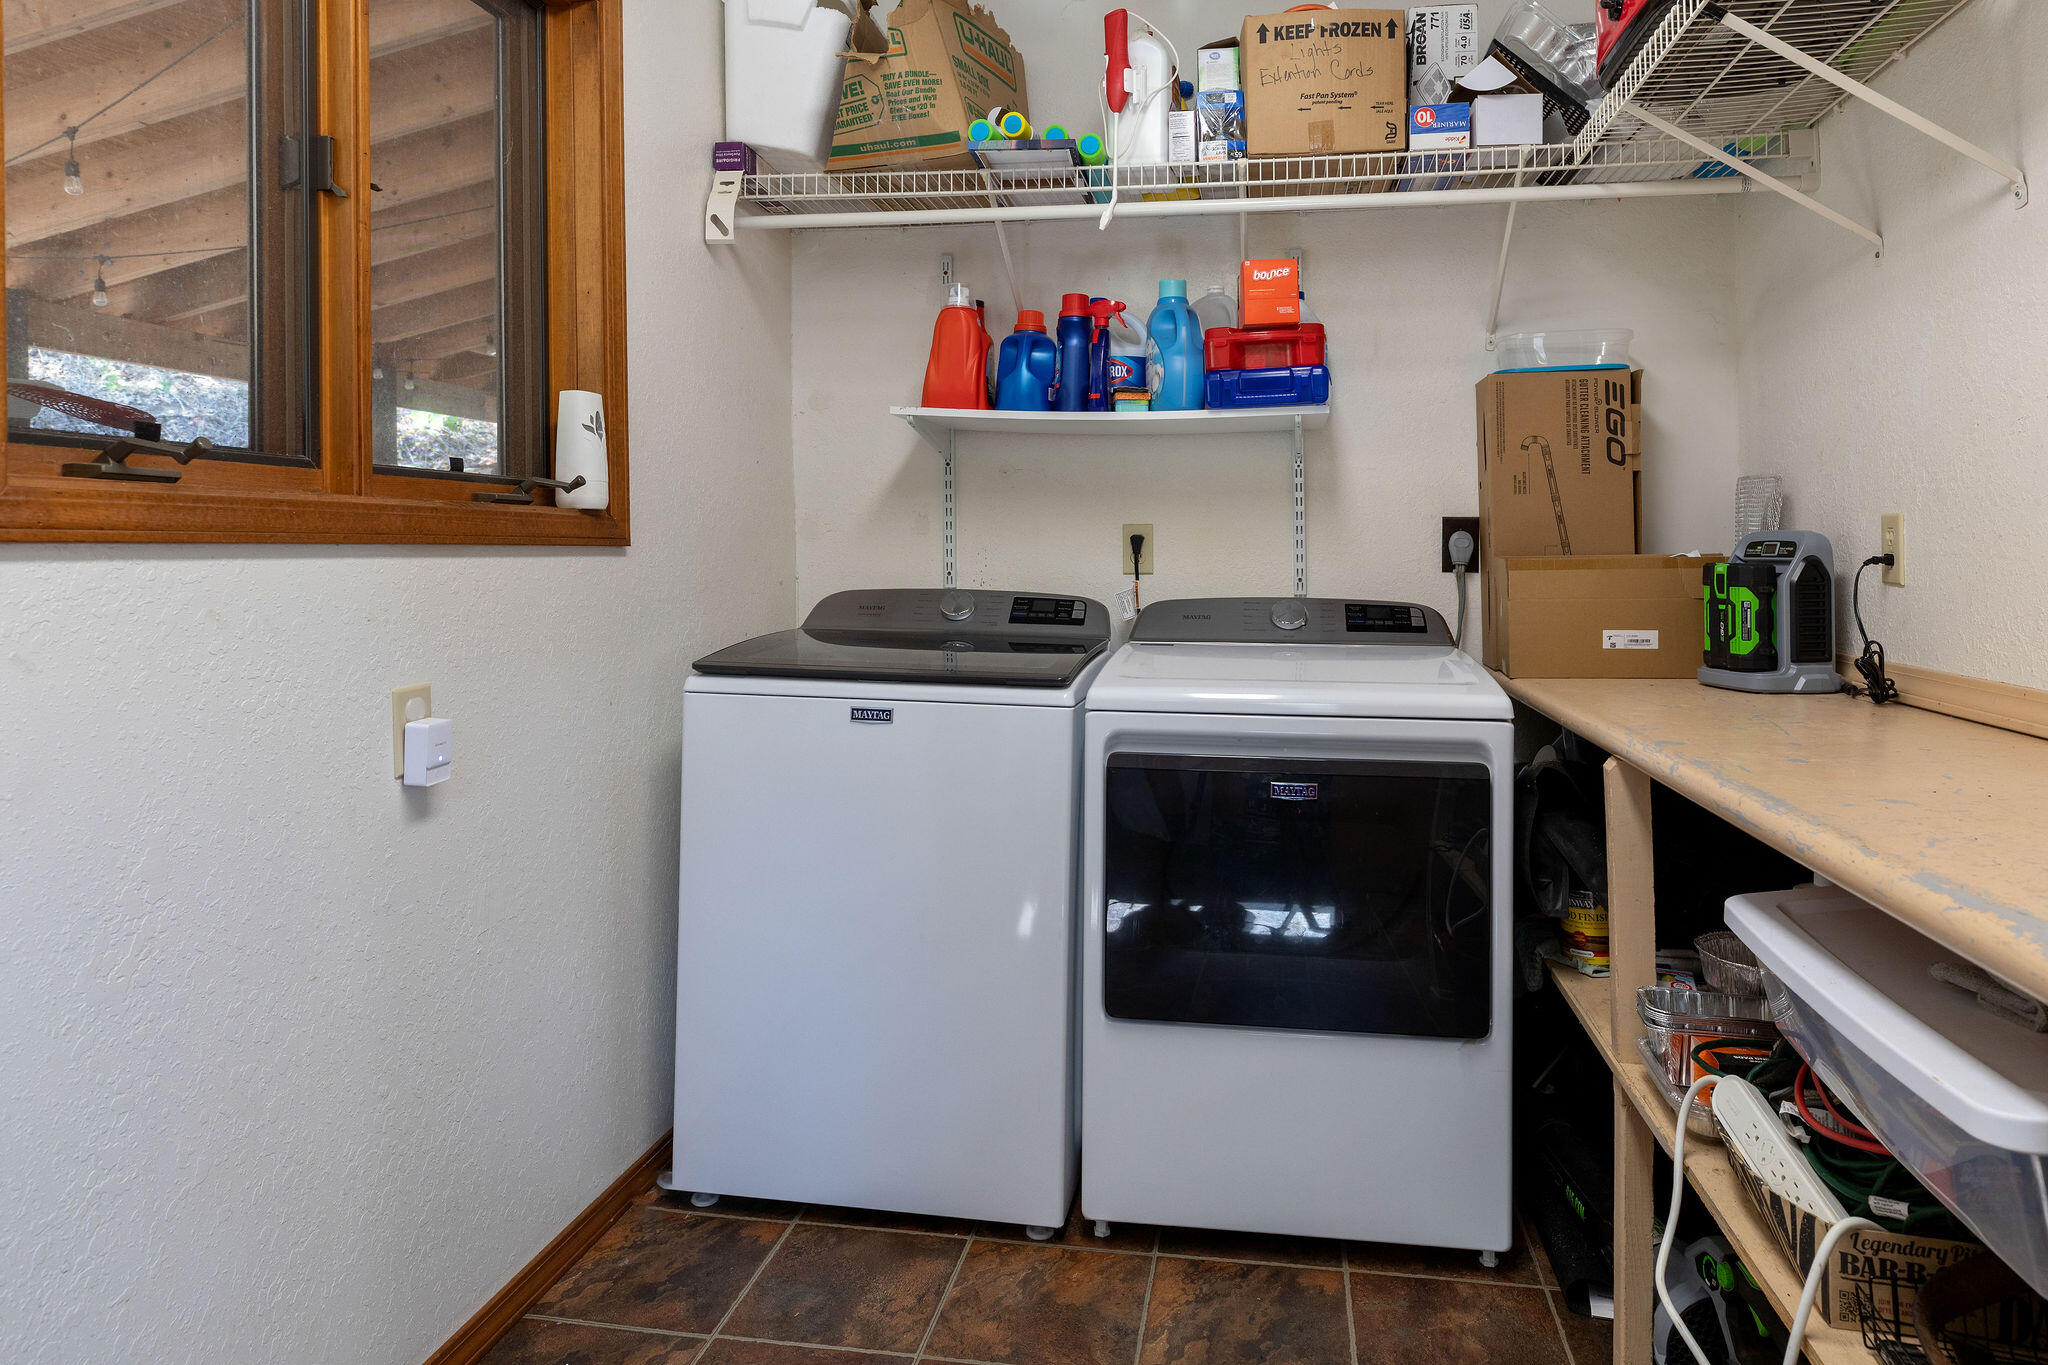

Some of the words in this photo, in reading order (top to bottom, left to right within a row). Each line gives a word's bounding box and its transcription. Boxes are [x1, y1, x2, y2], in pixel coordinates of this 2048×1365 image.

[1430, 11, 1440, 30] 771
[1274, 23, 1315, 41] KEEP
[1320, 22, 1382, 38] FROZEN
[1415, 12, 1427, 66] BROAN
[1461, 55, 1467, 66] 70
[842, 80, 865, 100] VE!
[884, 81, 901, 90] SAVE
[903, 79, 920, 87] EVEN
[845, 102, 869, 118] PRICE
[887, 98, 907, 106] Prices
[1417, 110, 1433, 123] 10
[1431, 120, 1467, 129] MARINER
[859, 140, 917, 153] uhaul.com
[1253, 267, 1290, 281] bounce
[1110, 365, 1128, 377] ROX
[1579, 378, 1589, 402] GUTTER
[1579, 403, 1590, 434] CLEANING
[1605, 379, 1626, 467] EGO
[1580, 435, 1591, 475] ATTACHMENT
[852, 710, 890, 720] MAYTAG
[1273, 786, 1315, 796] MAYTAG
[1850, 1232, 1951, 1265] Legendary
[1838, 1251, 1950, 1284] BAR-B-
